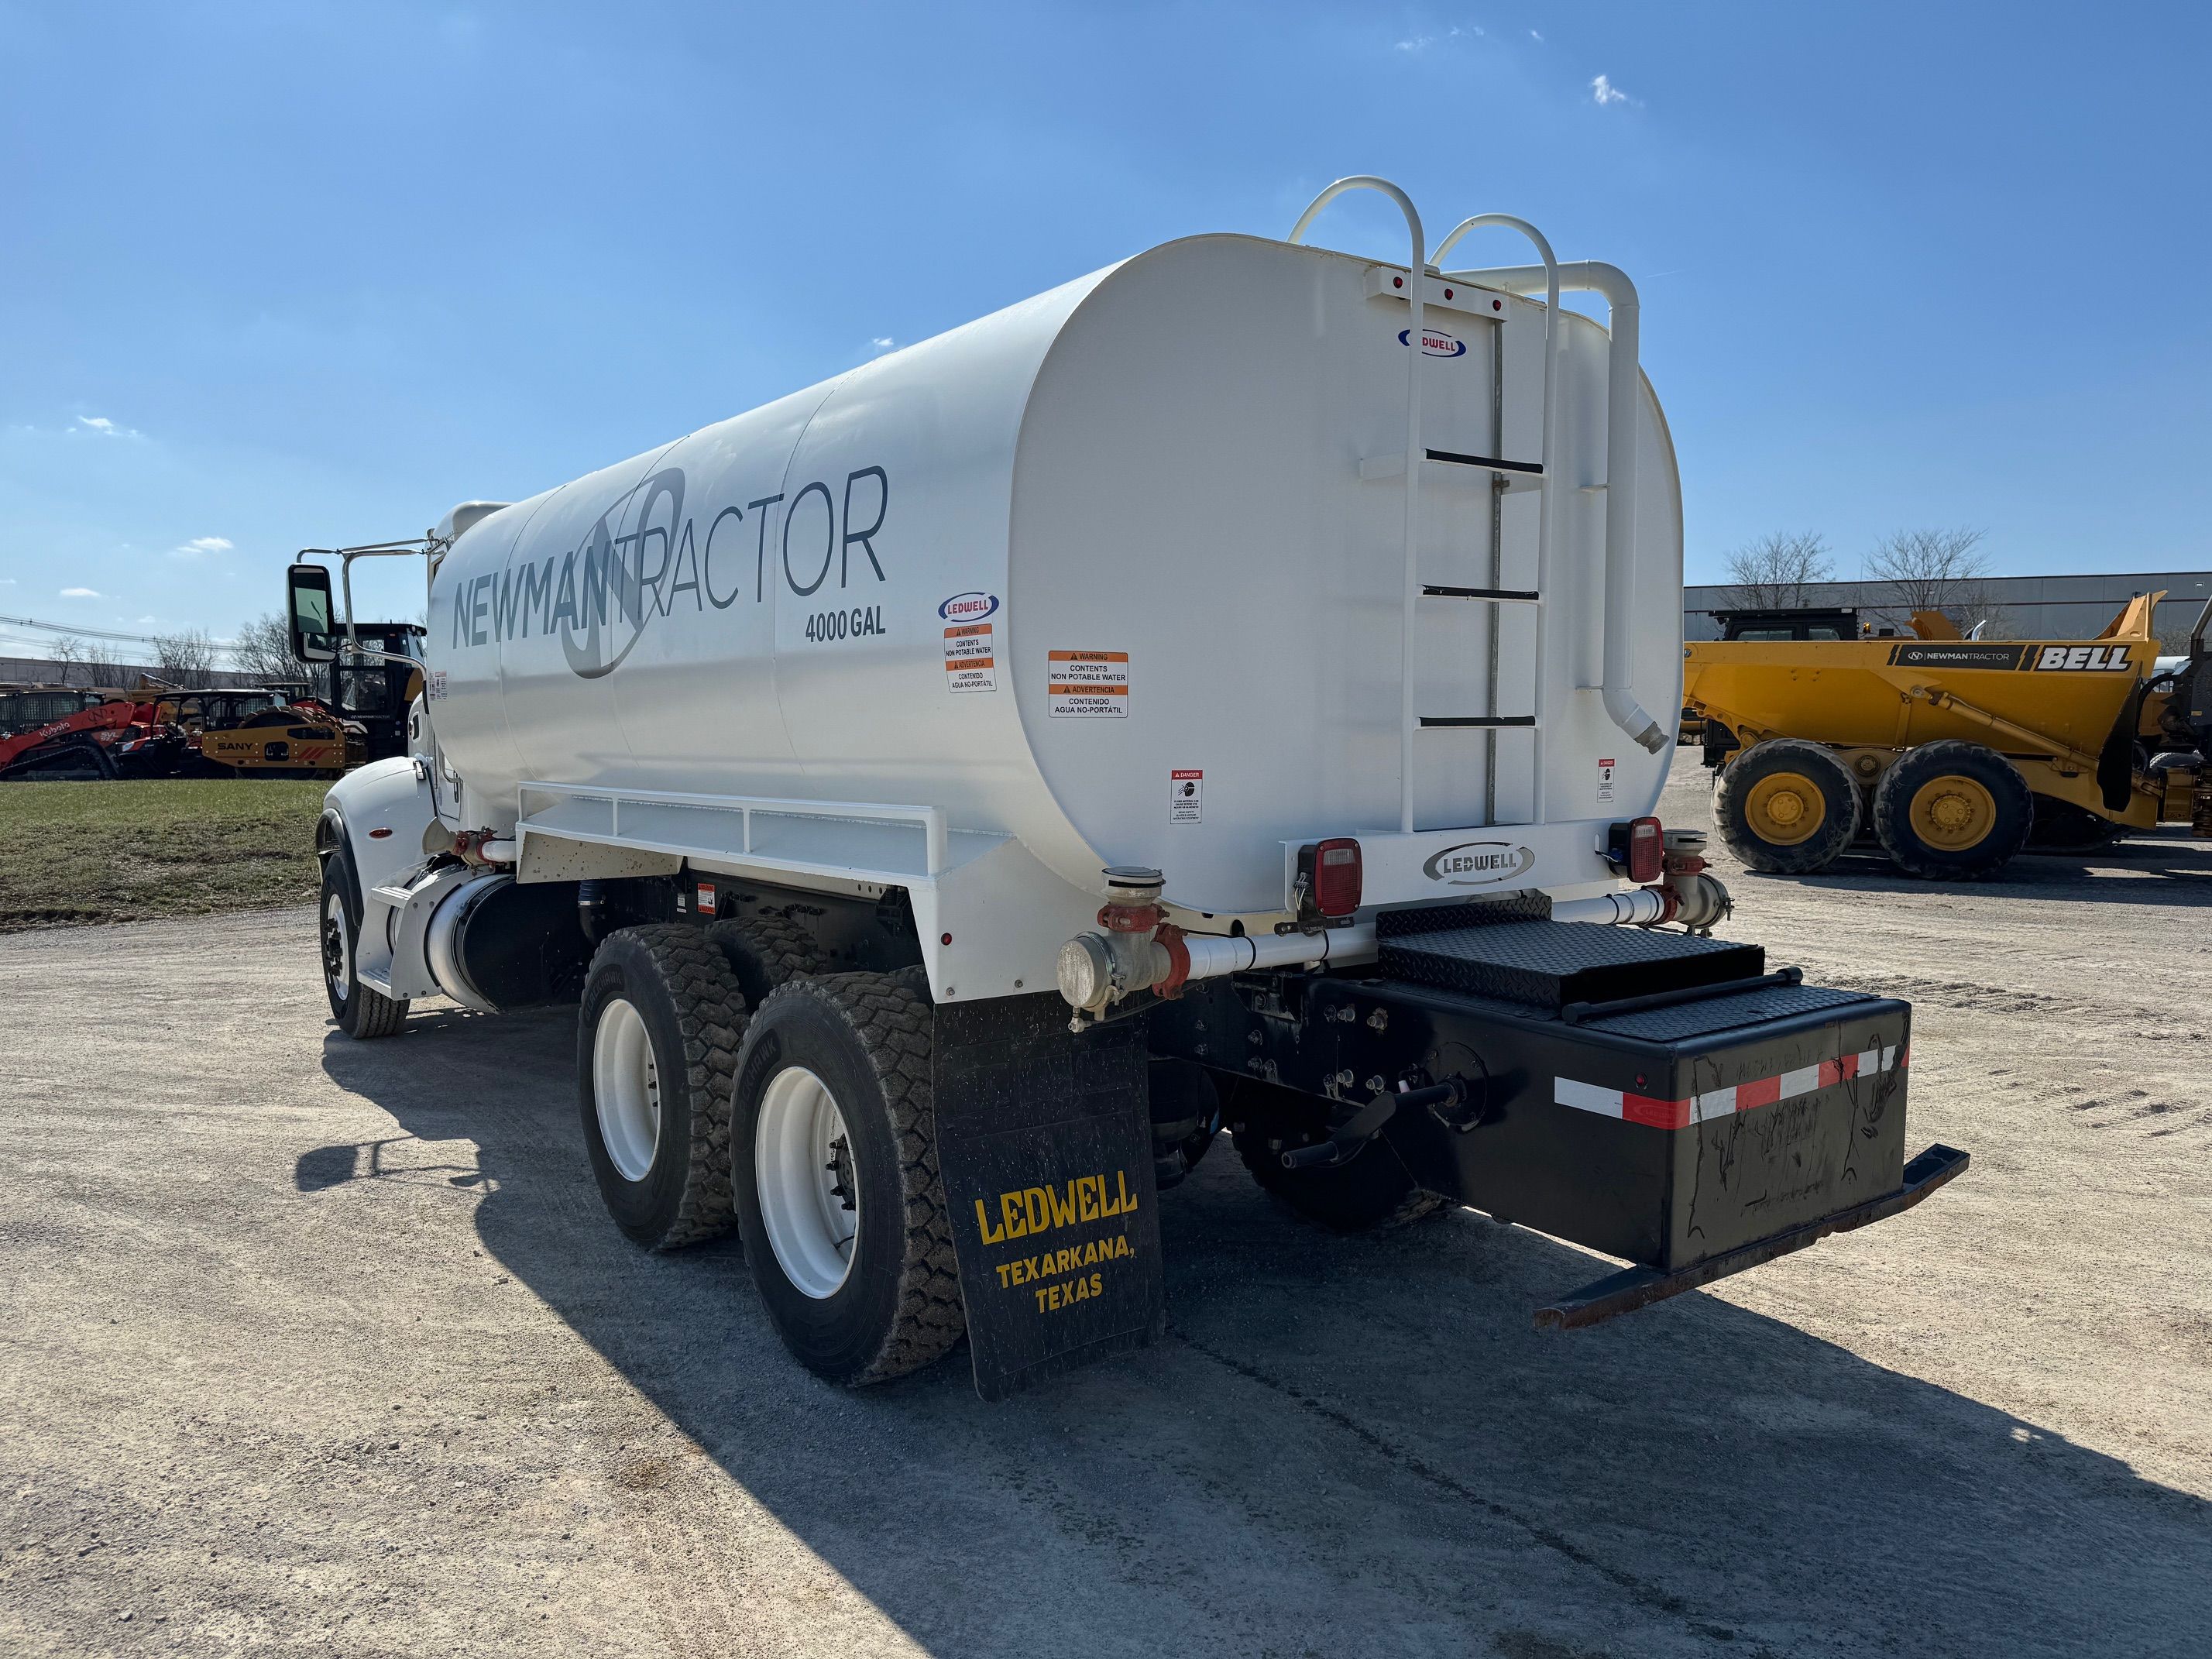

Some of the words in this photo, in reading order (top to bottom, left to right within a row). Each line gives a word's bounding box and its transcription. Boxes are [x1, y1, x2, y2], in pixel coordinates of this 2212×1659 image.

[1422, 336, 1455, 352] DWELL
[947, 599, 989, 615] LEDWELL
[805, 610, 847, 644] 4000
[850, 606, 886, 637] GAL
[962, 627, 979, 636] WARNING
[956, 639, 979, 647] CONTENTS
[959, 660, 985, 668] ADVERTENCIA
[2037, 647, 2130, 669] BELL
[39, 721, 70, 737] Kubota
[1444, 853, 1516, 874] LEDWELL
[974, 1170, 1138, 1245] LEDWELL
[995, 1235, 1135, 1289] TEXARKANA,
[1035, 1273, 1103, 1314] TEXAS
